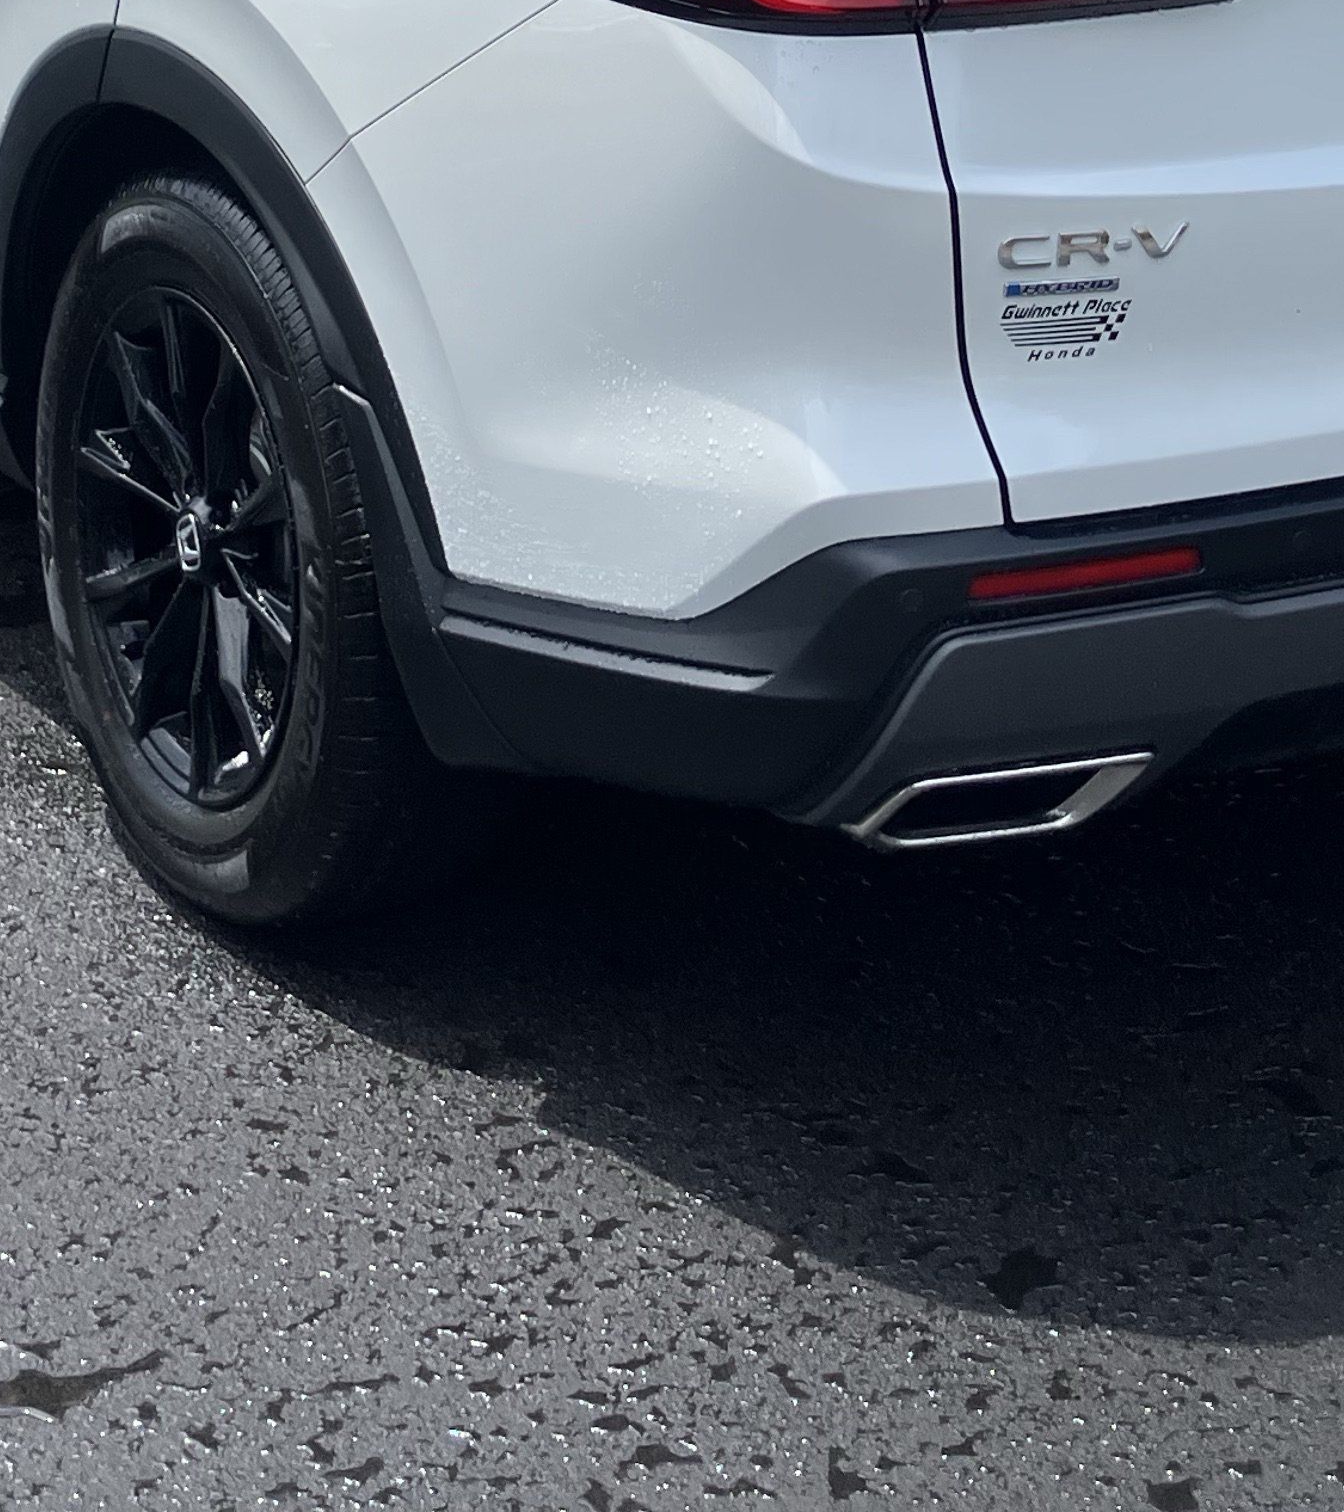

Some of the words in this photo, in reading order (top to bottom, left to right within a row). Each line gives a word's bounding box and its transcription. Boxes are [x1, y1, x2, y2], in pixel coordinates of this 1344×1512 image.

[997, 221, 1191, 270] CR-V
[1001, 300, 1080, 321] Gwinnett
[1083, 298, 1133, 315] Place
[1027, 346, 1096, 363] Honda
